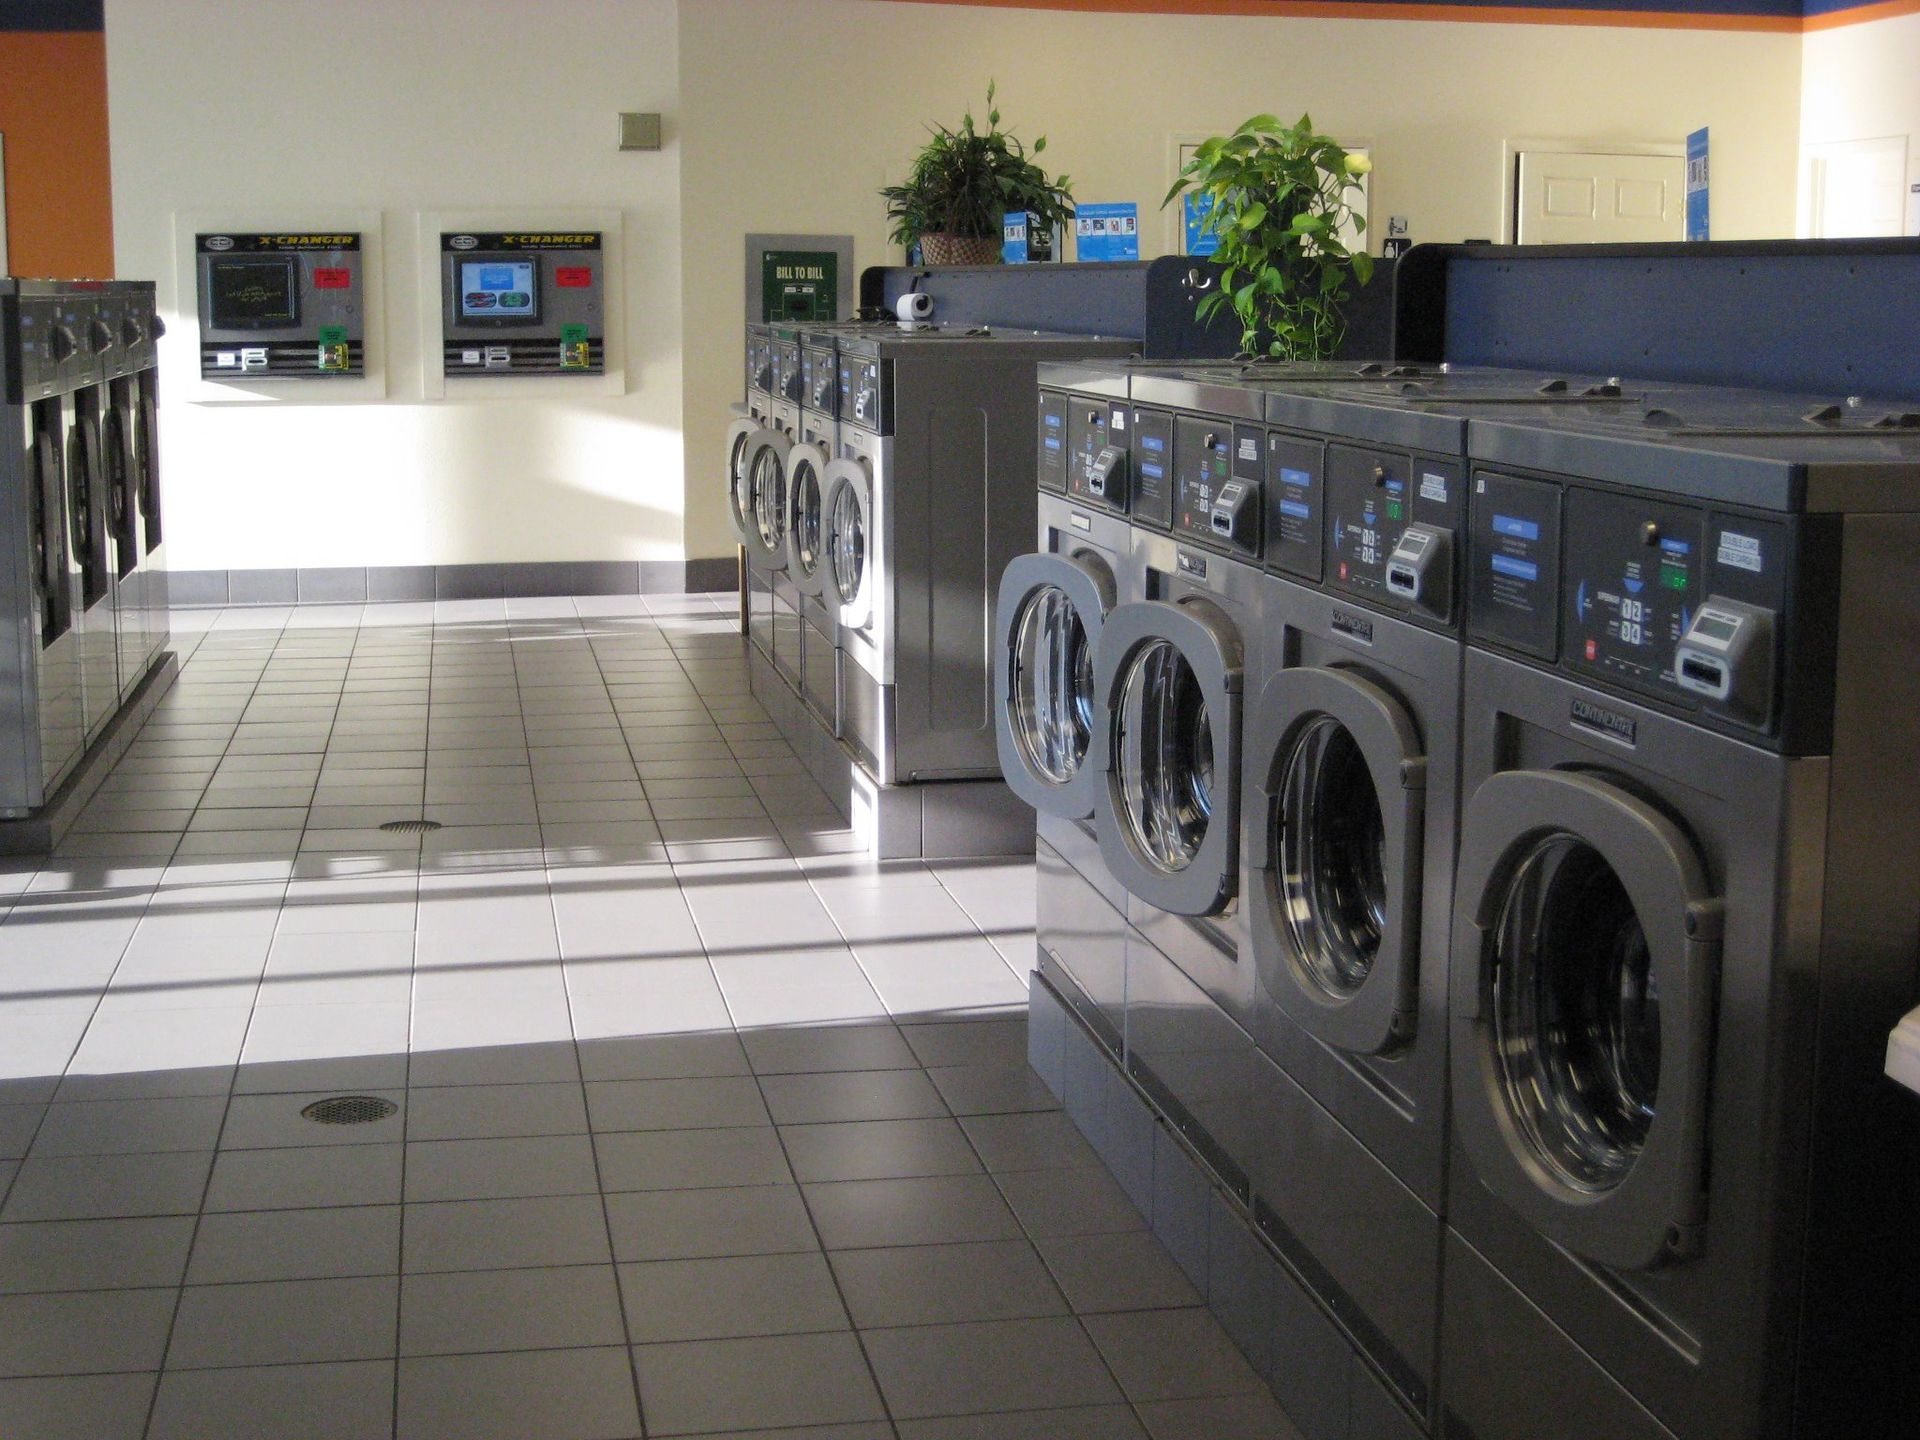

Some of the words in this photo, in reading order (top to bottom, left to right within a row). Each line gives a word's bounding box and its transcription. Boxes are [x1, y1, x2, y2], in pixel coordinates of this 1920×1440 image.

[259, 236, 354, 245] X-CHANGER
[503, 235, 595, 244] X-CHANGER
[776, 266, 793, 280] BILL
[794, 266, 806, 280] TO
[807, 266, 824, 280] BILL
